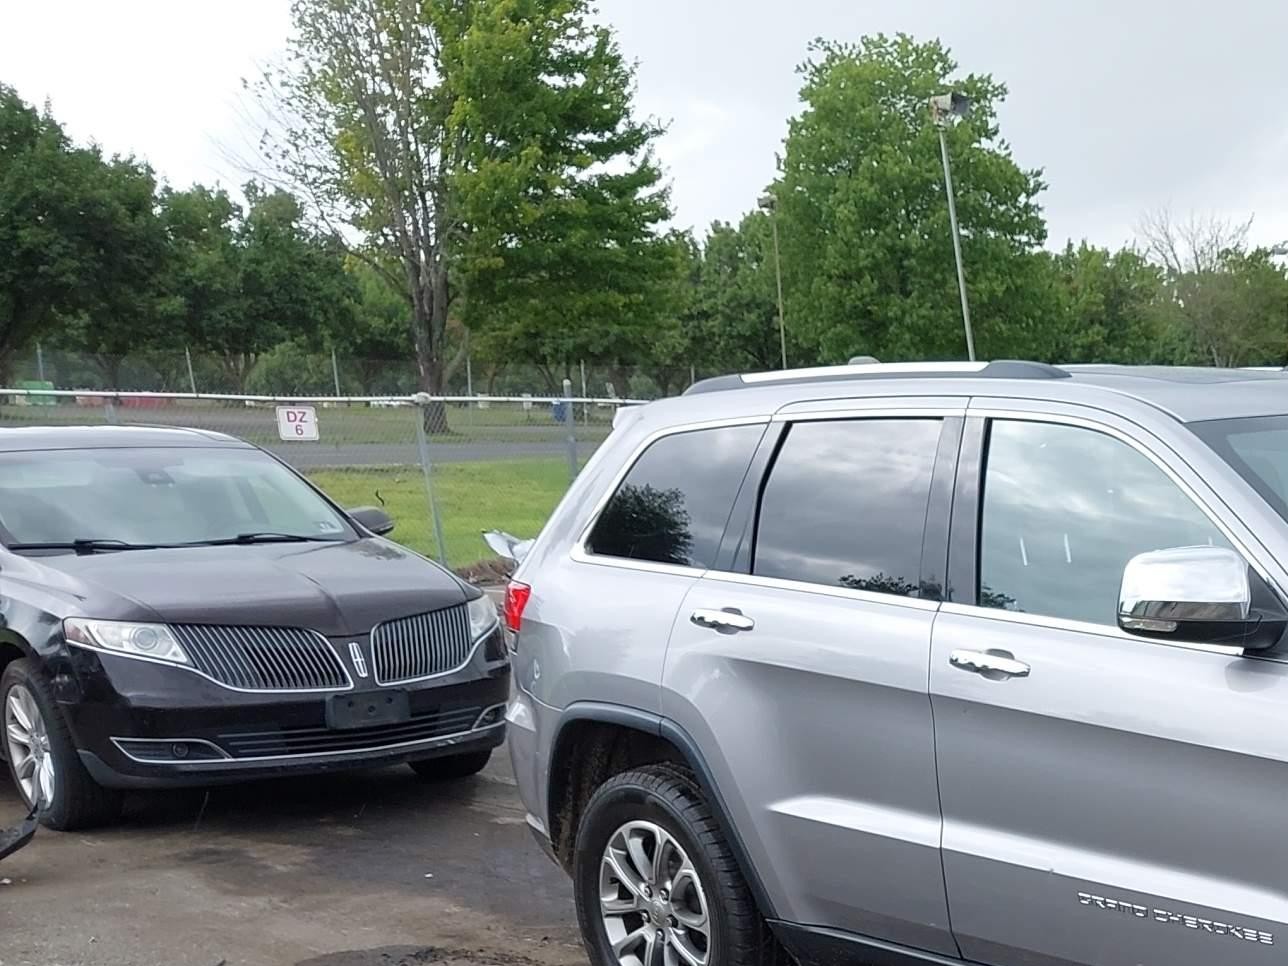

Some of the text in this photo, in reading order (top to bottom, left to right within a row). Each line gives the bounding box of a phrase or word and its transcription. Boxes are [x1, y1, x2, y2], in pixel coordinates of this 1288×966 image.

[287, 411, 308, 423] DZ
[295, 424, 304, 436] 6
[1078, 891, 1274, 945] GRAND CHEROKEE
